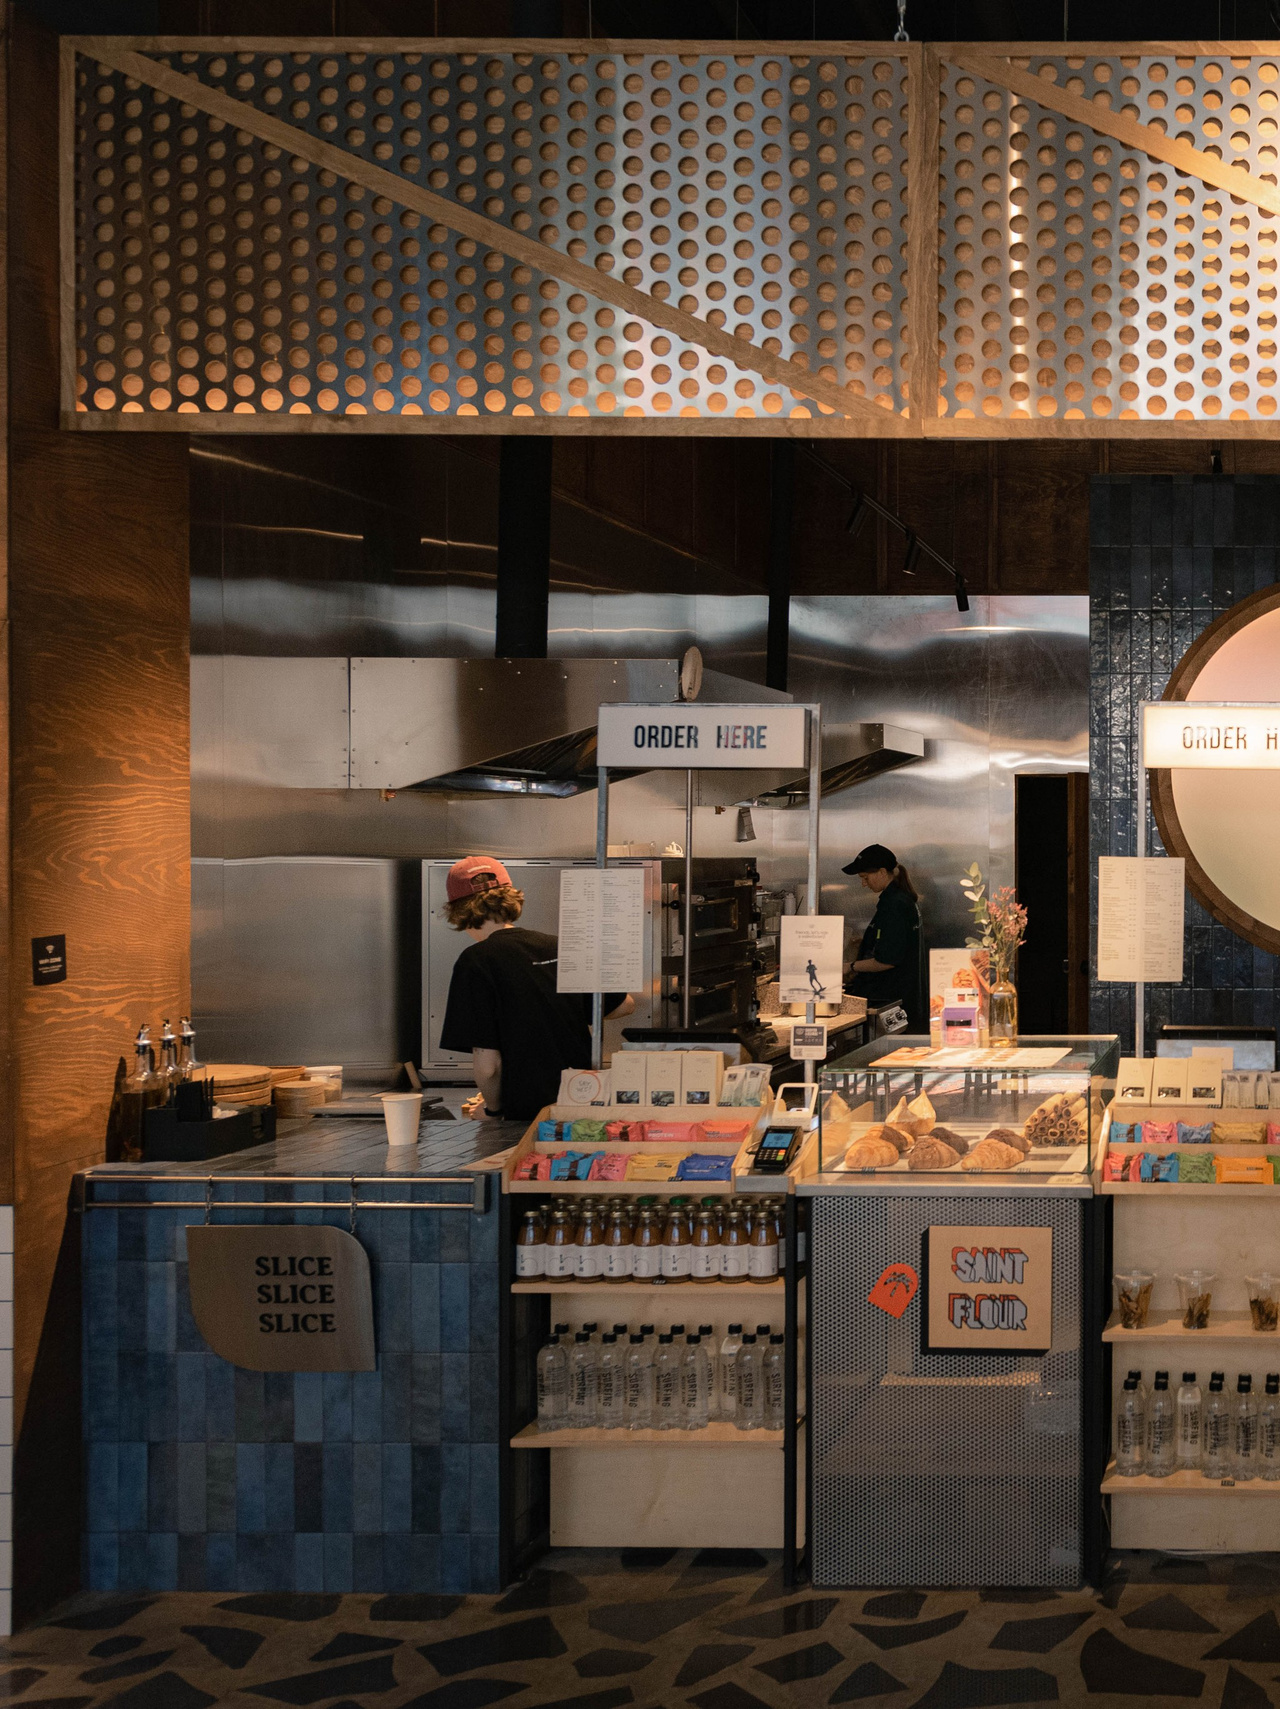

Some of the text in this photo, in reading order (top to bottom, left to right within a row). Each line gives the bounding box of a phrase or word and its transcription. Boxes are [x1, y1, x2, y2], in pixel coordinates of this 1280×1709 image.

[634, 725, 767, 748] ORDER HERE
[1183, 726, 1247, 749] ORDER
[255, 1256, 334, 1276] SLICE
[951, 1247, 1029, 1284] SAINT
[257, 1284, 335, 1304] SLICE
[948, 1293, 1028, 1330] FLOUR
[259, 1313, 337, 1333] SLICE
[628, 1372, 640, 1408] SURFING
[661, 1372, 673, 1408] SURFING
[686, 1373, 698, 1408] SURFING
[743, 1373, 754, 1408] SURFING
[771, 1373, 782, 1408] SURFING
